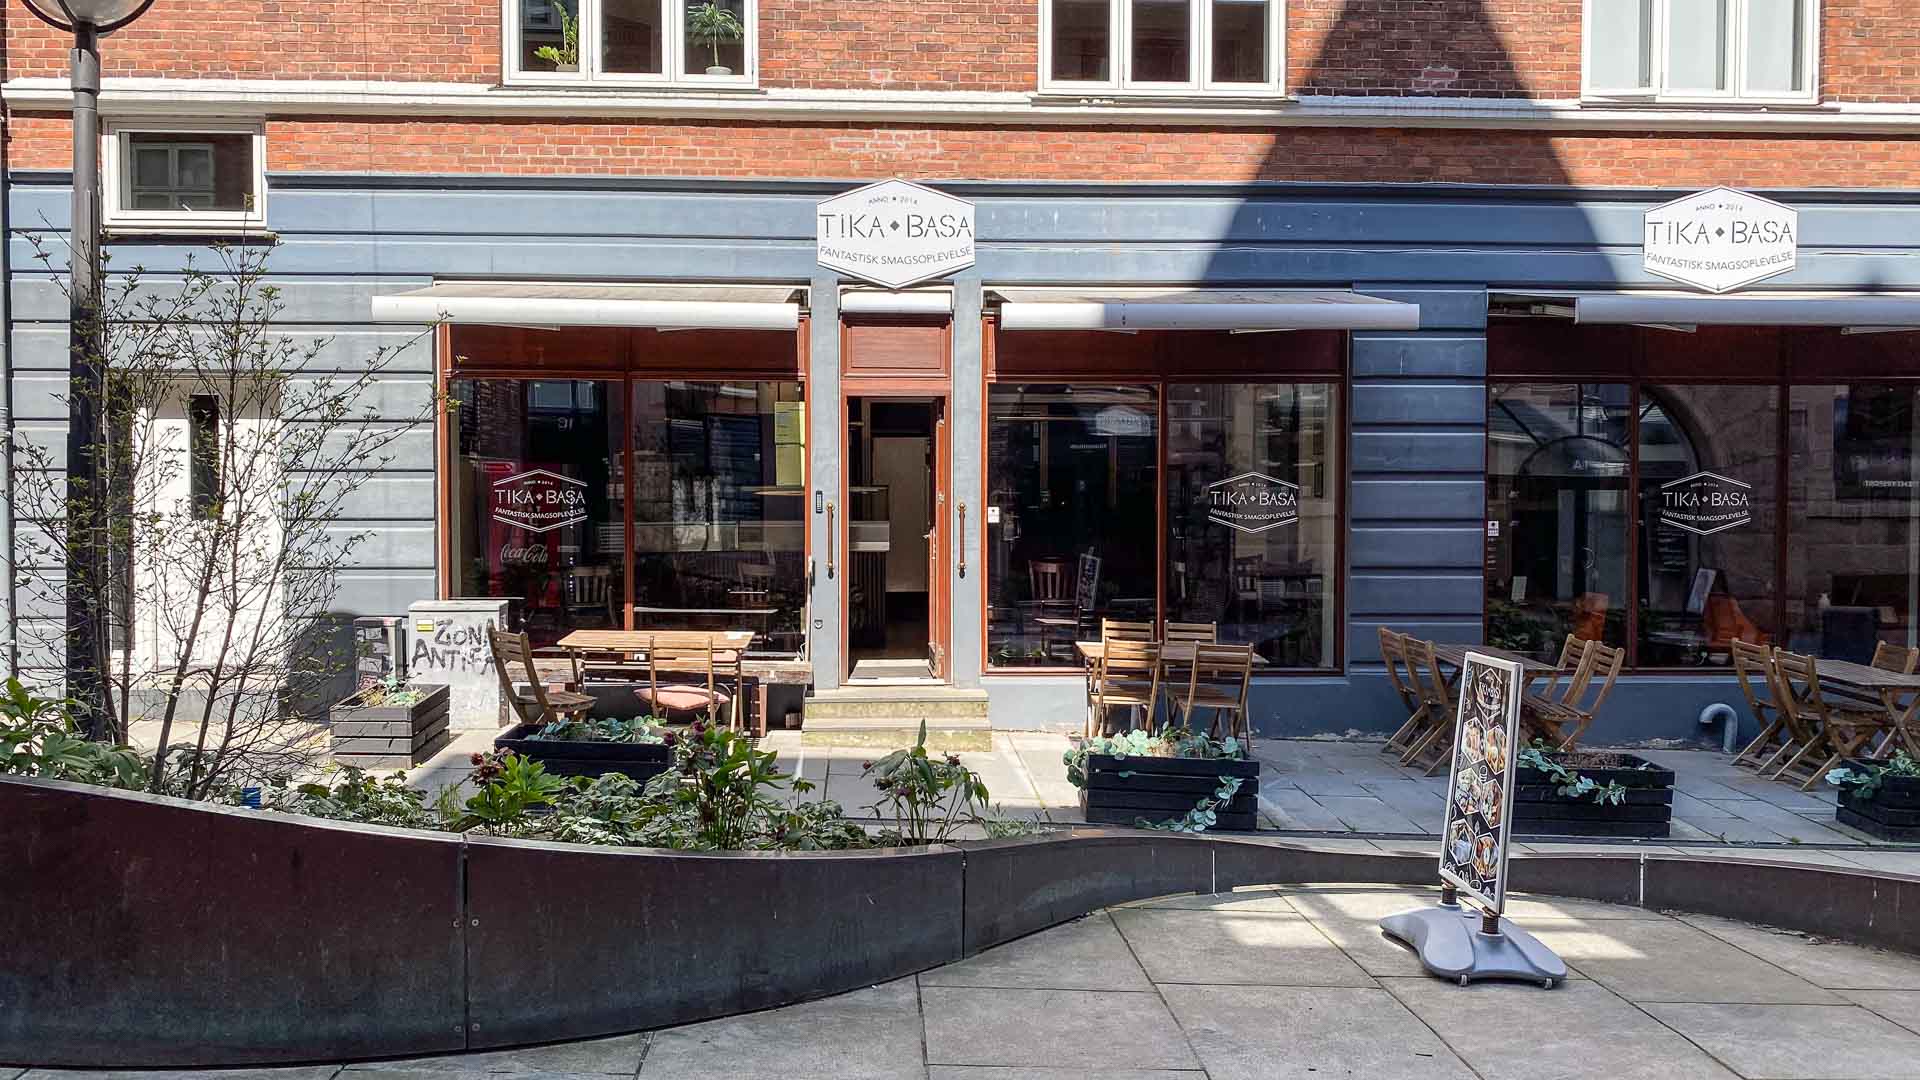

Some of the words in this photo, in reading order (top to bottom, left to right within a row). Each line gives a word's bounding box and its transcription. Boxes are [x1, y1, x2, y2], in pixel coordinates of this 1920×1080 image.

[819, 213, 885, 238] TIKA
[907, 214, 972, 238] BASA
[1647, 220, 1710, 245] TIKA
[1731, 220, 1794, 244] BASA
[819, 245, 880, 265] FANTASTISK
[881, 246, 973, 265] SMAGSOPLEVELSE
[1646, 252, 1703, 270] FANTASTISK
[1704, 251, 1793, 271] SMAGSOPLEVELSE
[494, 489, 535, 505] TIKA
[546, 489, 586, 505] BASA
[1210, 491, 1248, 506] TIKA
[1259, 492, 1297, 506] BASA
[1662, 492, 1700, 507] TIKA
[1711, 492, 1749, 507] BASA
[494, 506, 530, 519] FANTASTISK
[1210, 508, 1243, 519] FANTASTISK
[1244, 509, 1296, 520] SMAGSOPLEVELSE
[1662, 509, 1696, 520] FANTASTISK
[1696, 509, 1749, 521] SMAGSOPLEVELSE
